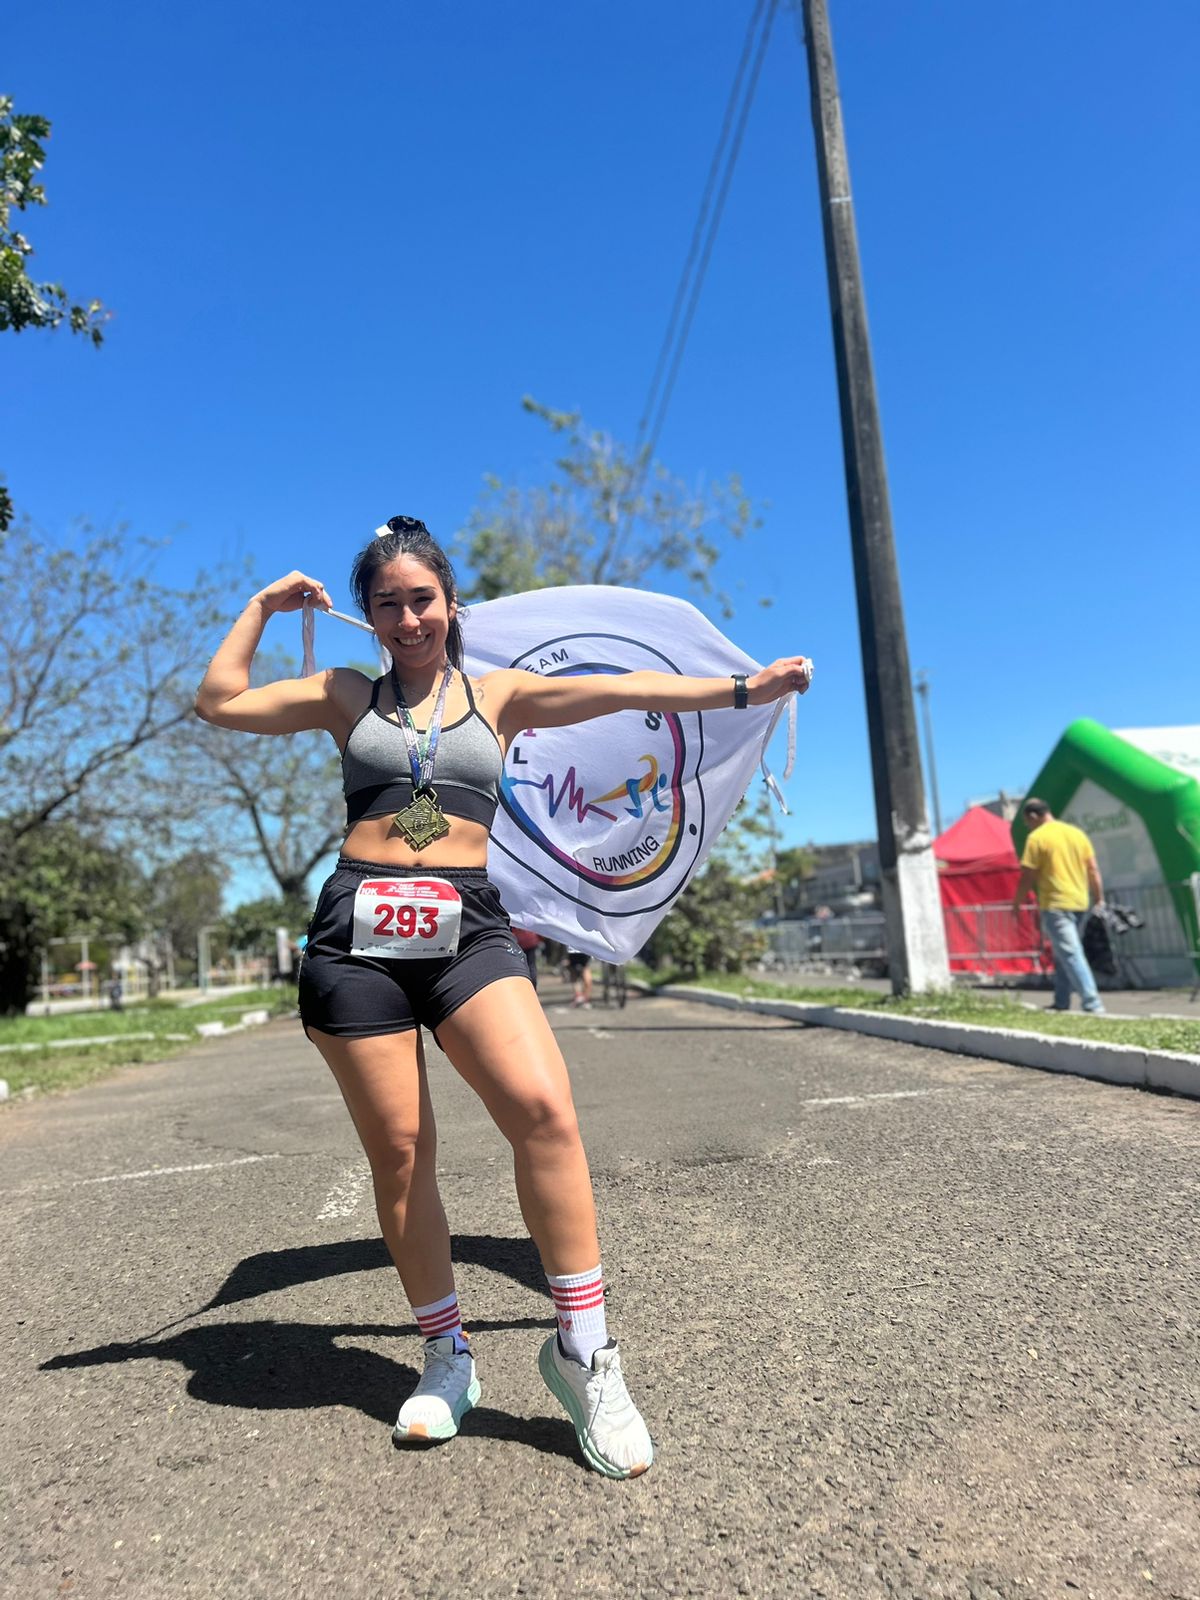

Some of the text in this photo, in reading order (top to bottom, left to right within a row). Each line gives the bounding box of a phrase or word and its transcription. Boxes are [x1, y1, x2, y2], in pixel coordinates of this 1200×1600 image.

[593, 835, 660, 872] RUNNING
[361, 887, 378, 895] 10K
[373, 903, 439, 939] 293
